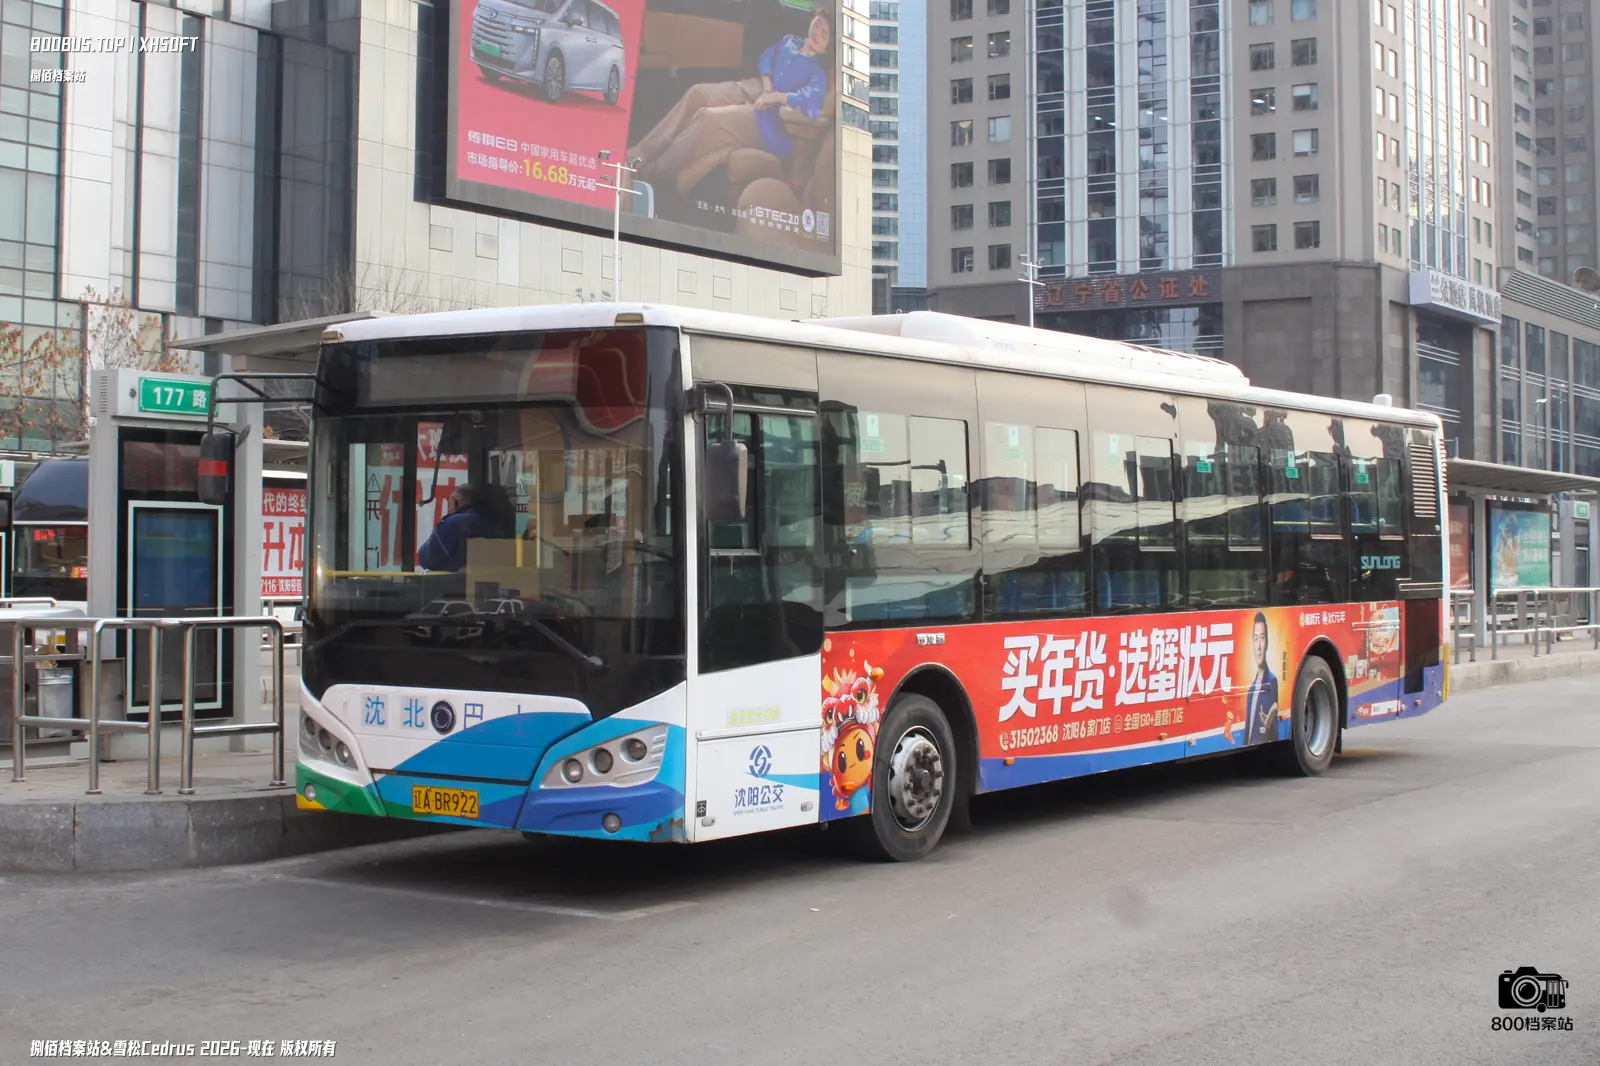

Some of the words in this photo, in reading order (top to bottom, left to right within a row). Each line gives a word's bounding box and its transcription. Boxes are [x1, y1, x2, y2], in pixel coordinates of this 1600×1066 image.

[521, 141, 597, 169] 中国家用车超优选
[1047, 275, 1208, 307] 辽宁省公证处
[153, 386, 185, 406] 177
[192, 389, 207, 408] 路
[1009, 724, 1058, 751] 31502368
[734, 784, 784, 808] 沈阳公交
